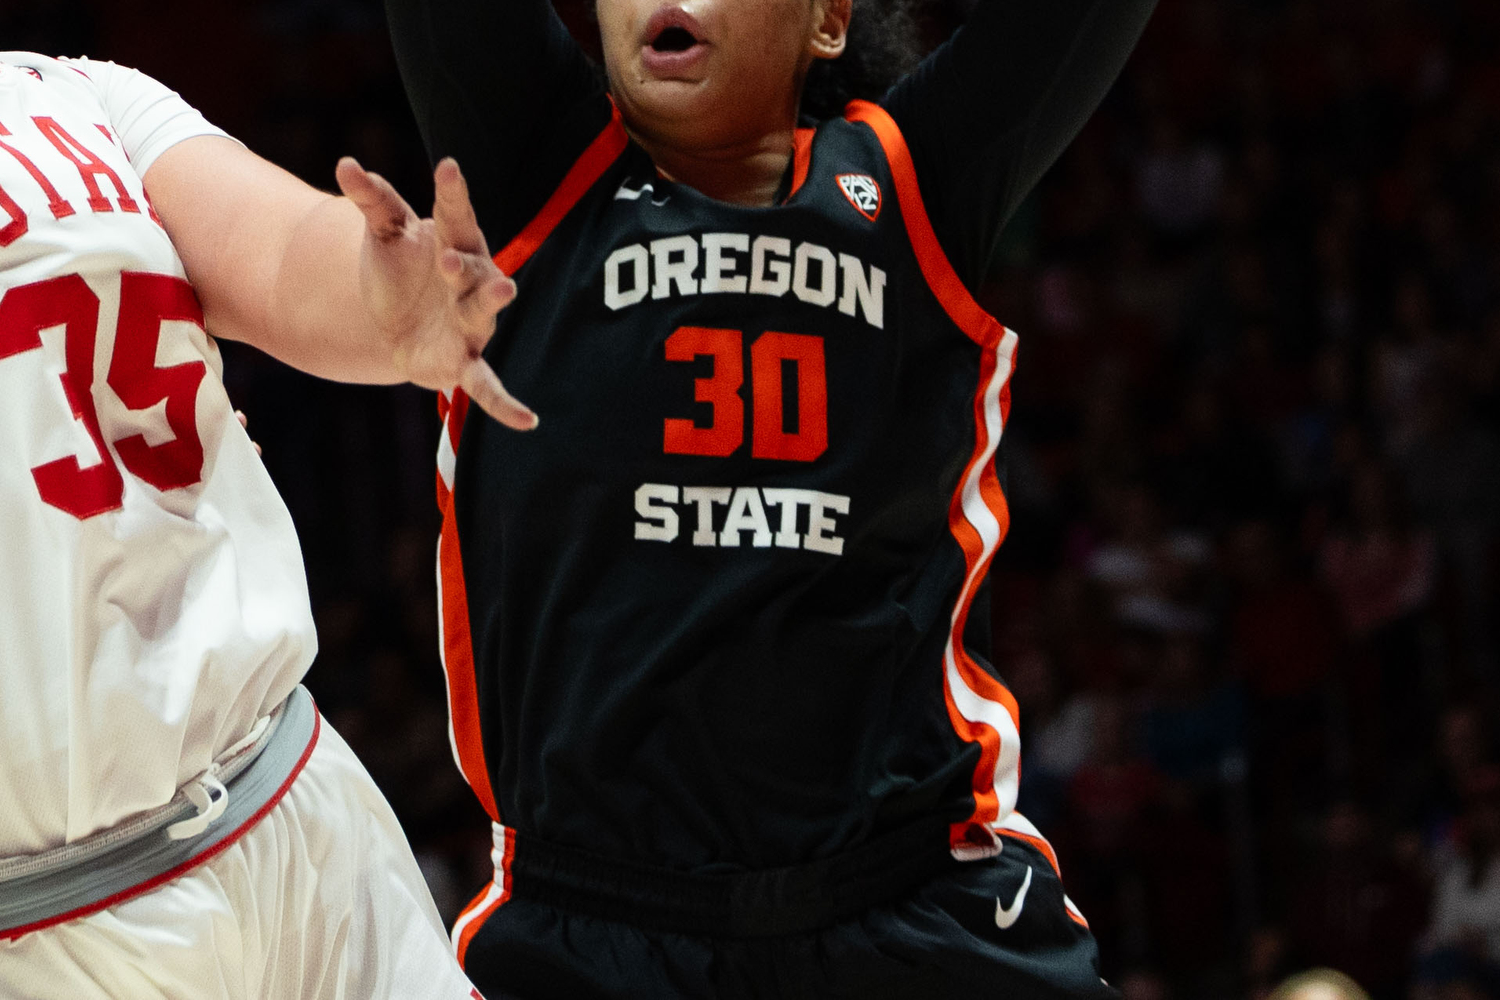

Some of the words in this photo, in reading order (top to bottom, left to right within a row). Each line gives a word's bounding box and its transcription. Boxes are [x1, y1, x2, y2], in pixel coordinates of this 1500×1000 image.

[604, 232, 887, 330] OREGON
[663, 326, 828, 463] 30
[634, 483, 851, 556] STATE
